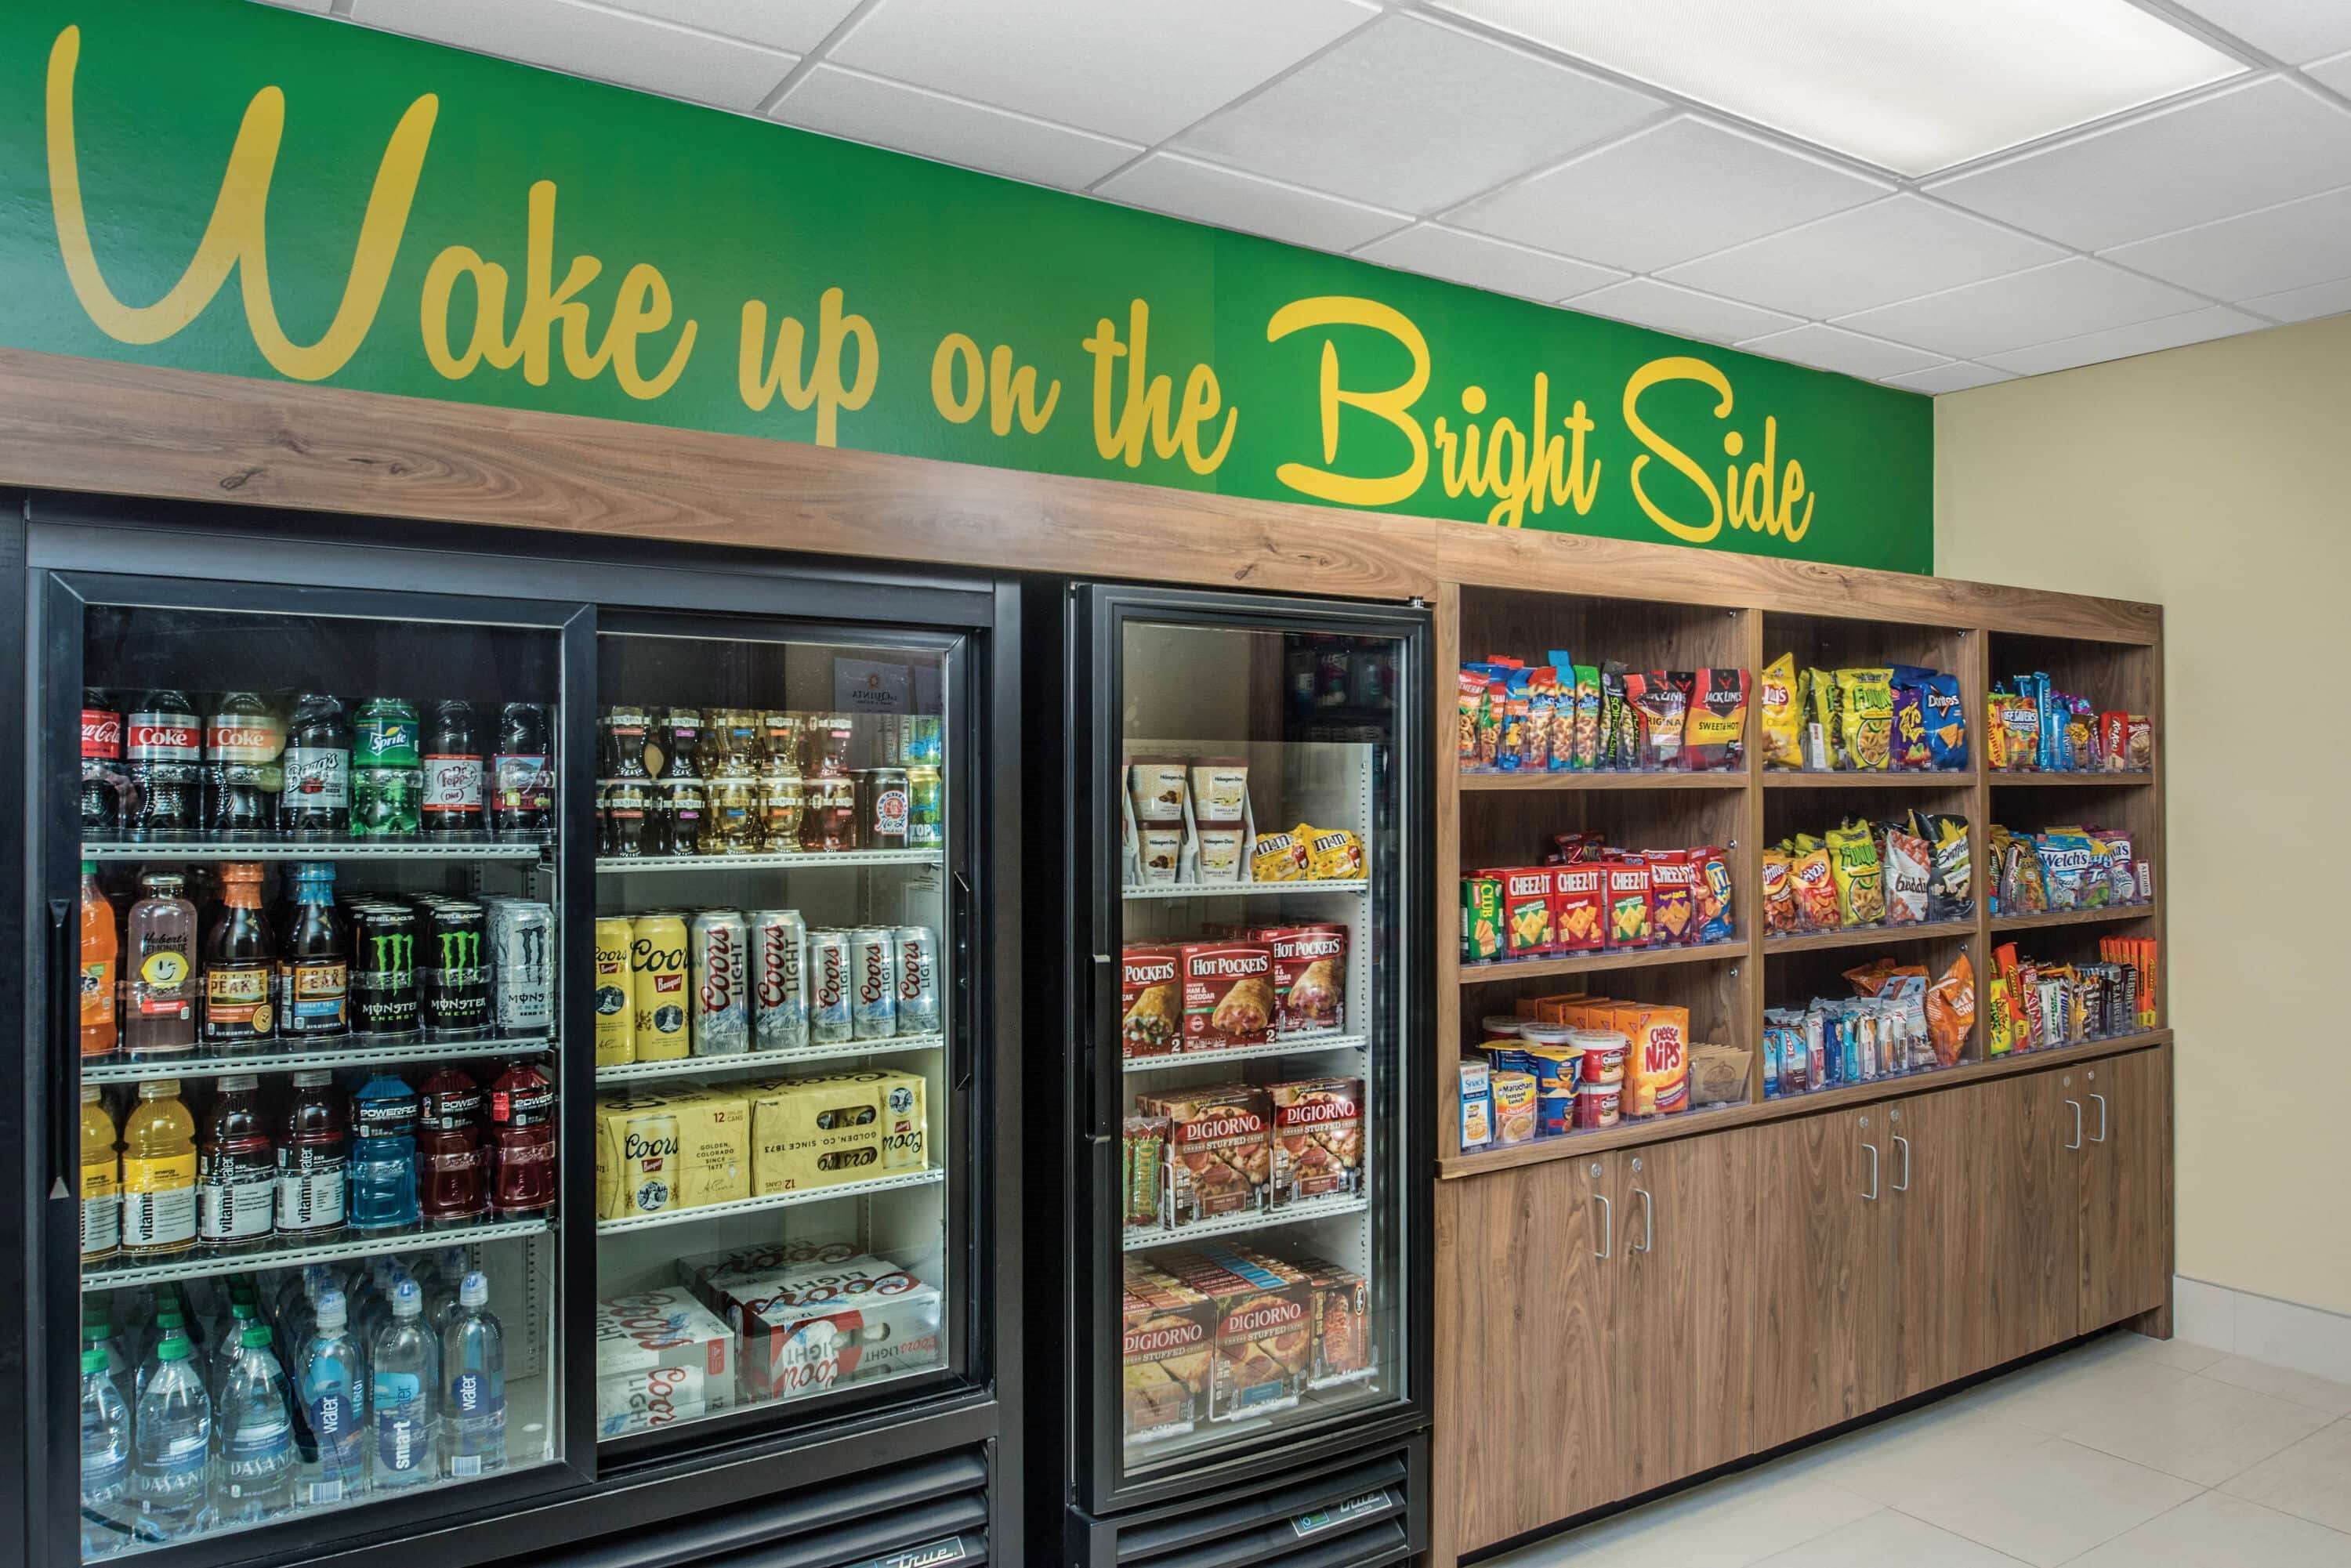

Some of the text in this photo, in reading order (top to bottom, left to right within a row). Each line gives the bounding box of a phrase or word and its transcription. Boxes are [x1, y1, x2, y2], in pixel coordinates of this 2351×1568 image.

[47, 26, 1815, 543] Wake up on the Bright Side
[1704, 691, 1723, 704] JACK
[1927, 694, 1960, 708] Doritos
[1608, 696, 1620, 758] PISTACHIOS
[1699, 721, 1722, 730] SWEET
[139, 727, 188, 745] Coke
[218, 727, 264, 745] Coke
[372, 731, 408, 750] Sprite
[2039, 852, 2091, 868] Welch's
[1480, 883, 1494, 918] CLUB
[143, 933, 187, 946] Hubert's
[1274, 939, 1340, 958] HOT POCKETS
[142, 943, 188, 956] LEMONADE
[701, 926, 730, 1015] Coors
[731, 942, 743, 996] LIGHT
[758, 925, 785, 1010] Coors
[786, 940, 799, 992] LIGHT
[860, 944, 882, 1005] Coors
[882, 954, 891, 992] LIGHT
[900, 940, 920, 1001] Coors
[920, 951, 930, 988] LIGHT
[1125, 962, 1175, 982] POCKETS
[1193, 955, 1269, 976] HOT POCKETS
[819, 947, 840, 1009] Coors
[840, 957, 849, 995] LIGHT
[211, 980, 251, 994] PEAK
[431, 998, 486, 1011] MONSTER
[1186, 992, 1215, 1001] CHEDDAR
[1266, 1029, 1275, 1043] 2
[1172, 1039, 1181, 1052] 2
[1502, 1082, 1534, 1092] Maruchan
[441, 1096, 481, 1110] POWER
[514, 1094, 553, 1107] POWER
[360, 1106, 418, 1118] POWERADE
[713, 1111, 726, 1124] 12
[1304, 1121, 1341, 1134] STUFFED
[625, 1133, 679, 1161] Coors
[764, 1143, 786, 1154] 1873
[787, 1139, 817, 1151] SINCE
[882, 1131, 922, 1153] Coors
[1206, 1136, 1246, 1150] STUFFED
[696, 1147, 735, 1159] COLORADO
[705, 1156, 726, 1165] SINCE
[784, 1179, 797, 1190] 12
[777, 1269, 870, 1294] LIGHT
[744, 1272, 922, 1316] Coors
[602, 1291, 694, 1351] Coors
[1247, 1325, 1287, 1342] STUFFED
[1143, 1347, 1186, 1361] STUFFED
[647, 1366, 686, 1426] Coor
[230, 1451, 289, 1478] DASANI
[142, 1472, 204, 1493] DASANI
